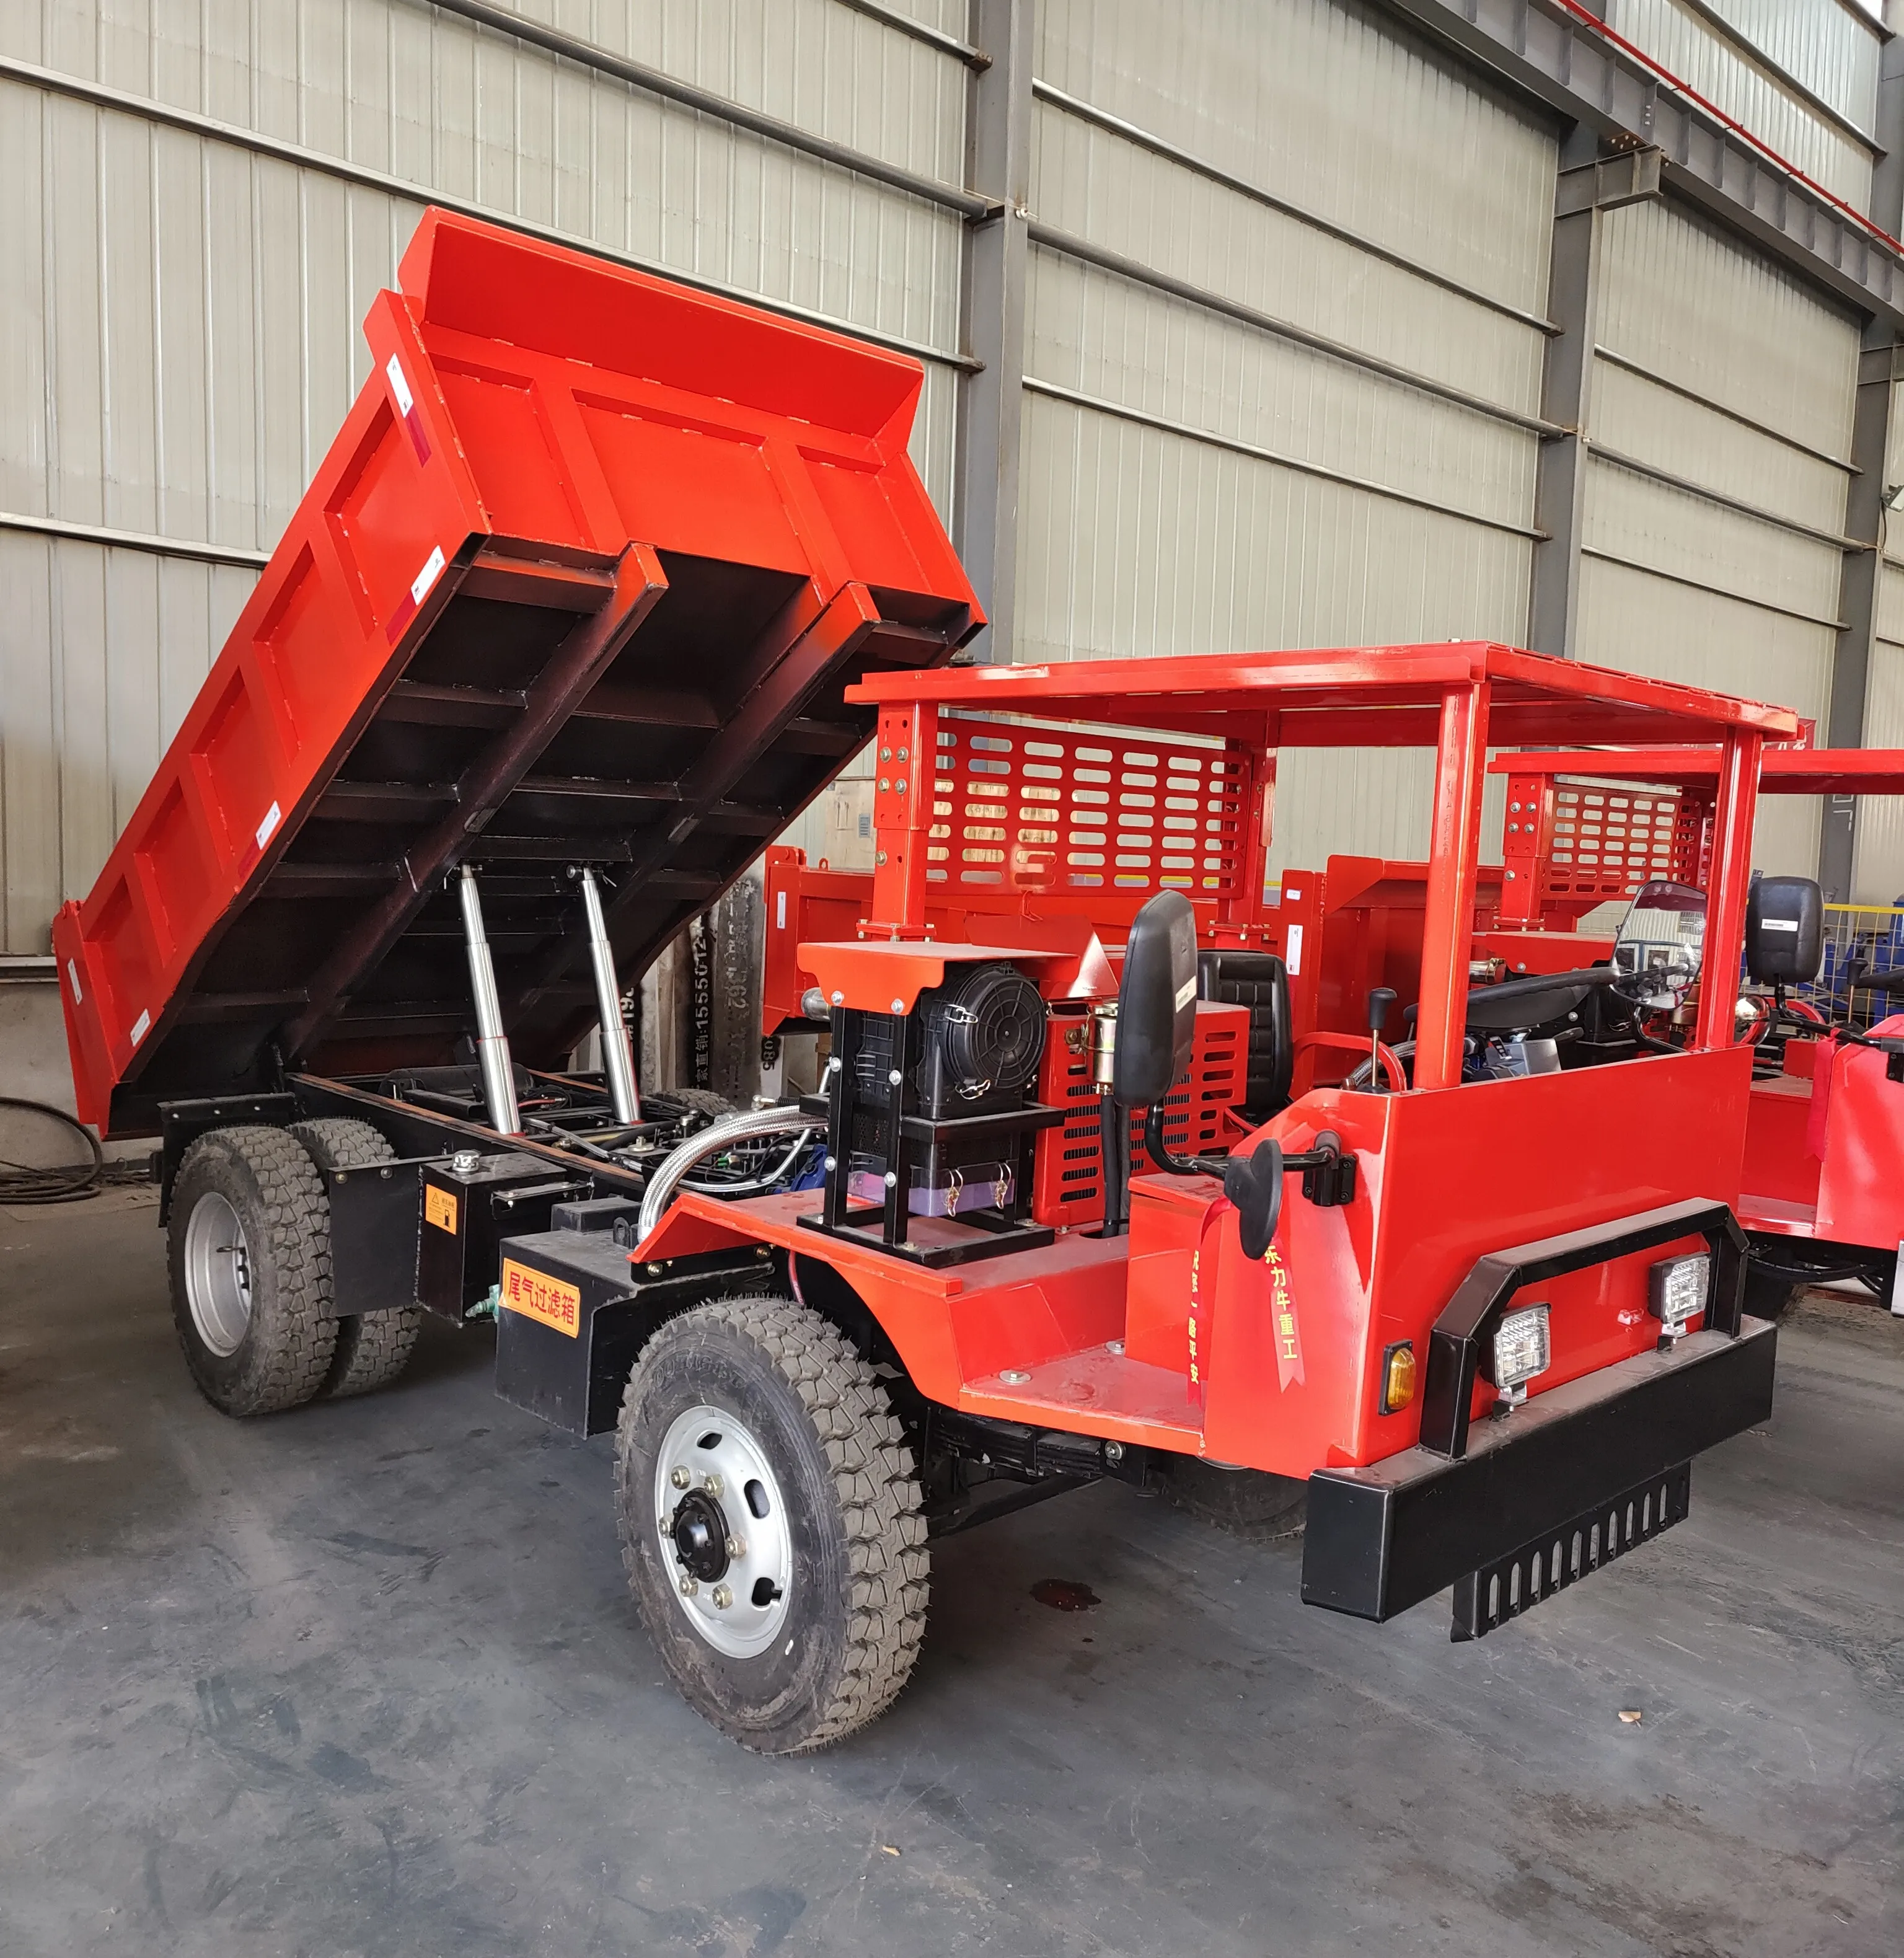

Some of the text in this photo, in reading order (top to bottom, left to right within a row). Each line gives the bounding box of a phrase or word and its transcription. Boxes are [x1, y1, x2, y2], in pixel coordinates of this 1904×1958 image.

[509, 1271, 575, 1326] 尾气过滤箱
